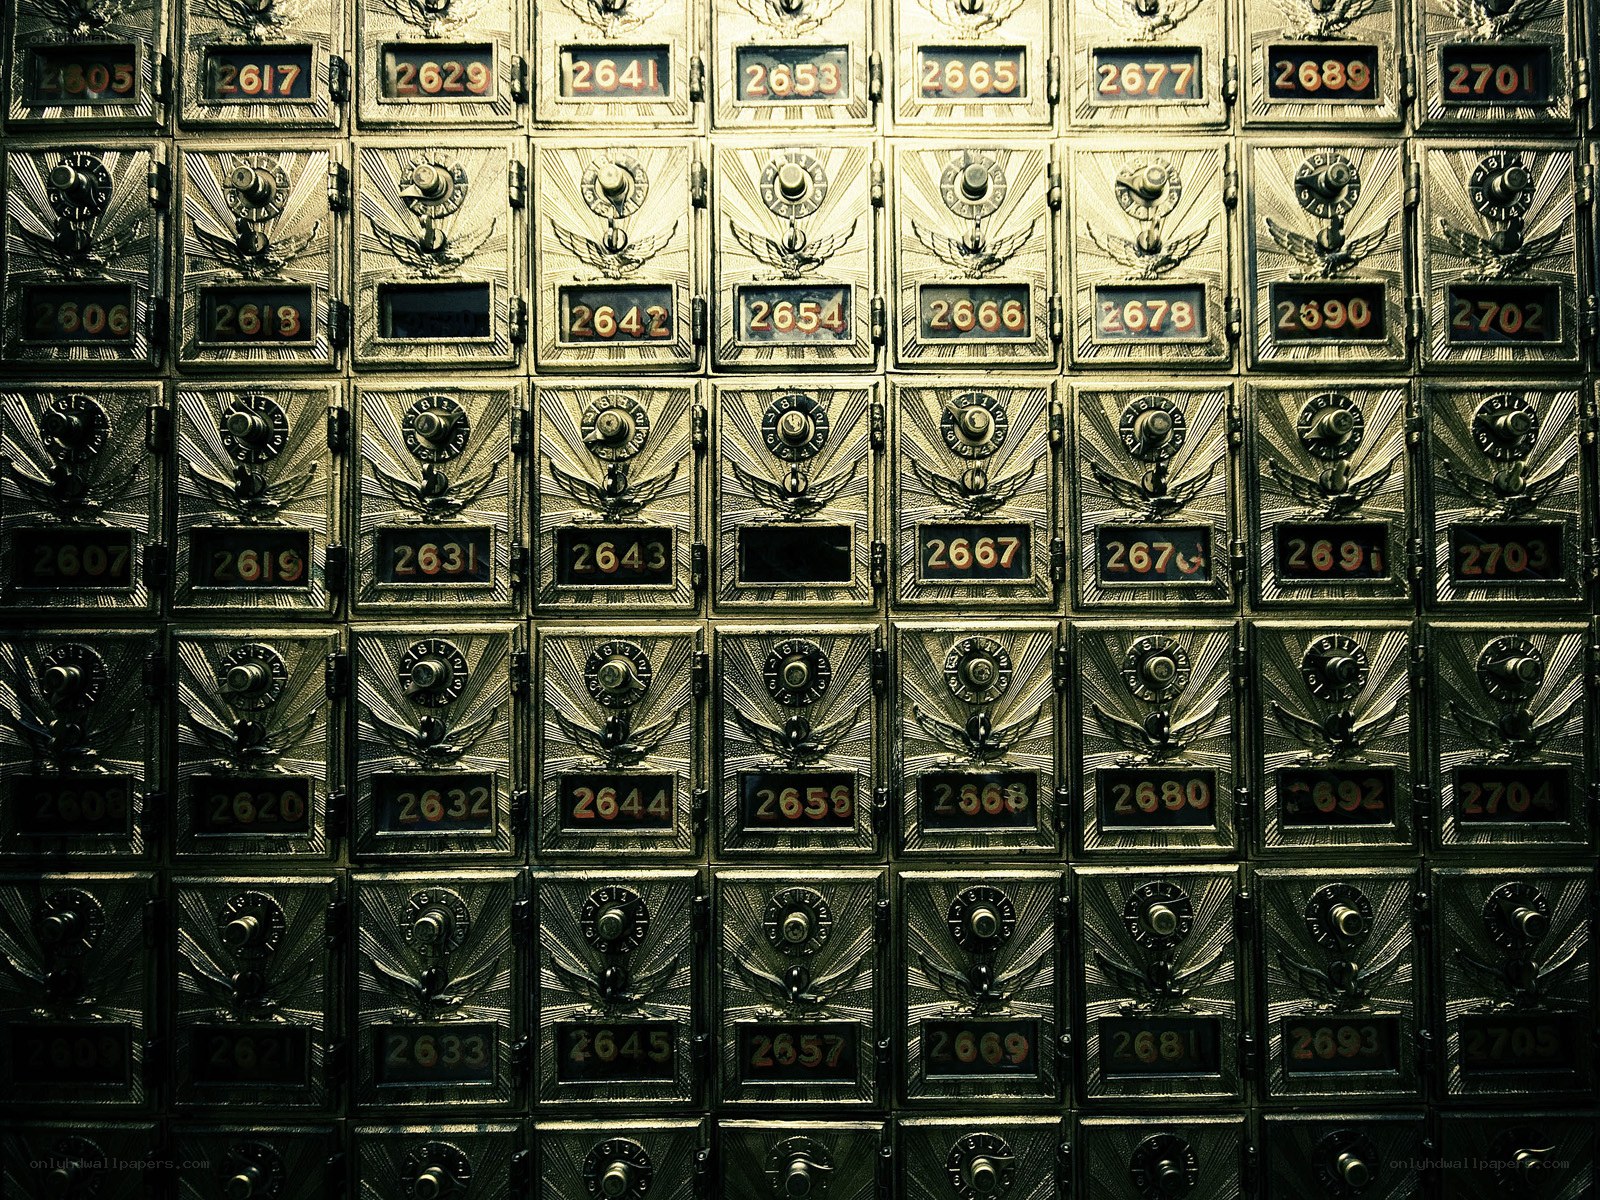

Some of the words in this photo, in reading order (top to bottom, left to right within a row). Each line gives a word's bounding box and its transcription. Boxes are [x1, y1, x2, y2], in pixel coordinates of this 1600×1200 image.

[217, 63, 301, 95] 2617
[395, 62, 491, 94] 2629
[571, 59, 660, 92] 2641
[745, 62, 840, 95] 2653
[922, 59, 1017, 93] 2665
[1098, 62, 1195, 94] 2677
[1275, 59, 1370, 91] 2689
[1448, 63, 1534, 94] 2701
[36, 301, 130, 335] 2606
[215, 304, 302, 338] 2618
[571, 301, 669, 337] 2642
[750, 299, 844, 334] 2654
[930, 299, 1025, 332] 2666
[1102, 300, 1195, 334] 2678
[1277, 297, 1372, 332] 2690
[1453, 299, 1544, 332] 2702
[34, 545, 129, 577] 2607
[214, 549, 303, 581] 2619
[394, 542, 479, 576] 2631
[572, 542, 667, 576] 2643
[926, 537, 1019, 570] 2667
[1460, 541, 1549, 575] 2703
[210, 789, 304, 823] 2620
[397, 787, 490, 823] 2632
[572, 787, 669, 821] 2644
[756, 785, 852, 820] 2656
[1112, 778, 1210, 814] 2680
[1461, 780, 1553, 814] 2704
[388, 1034, 486, 1070] 2633
[569, 1029, 671, 1063] 2645
[752, 1033, 846, 1067] 2657
[930, 1028, 1030, 1064] 2669
[1112, 1030, 1202, 1064] 2681
[1290, 1026, 1380, 1061] 2693
